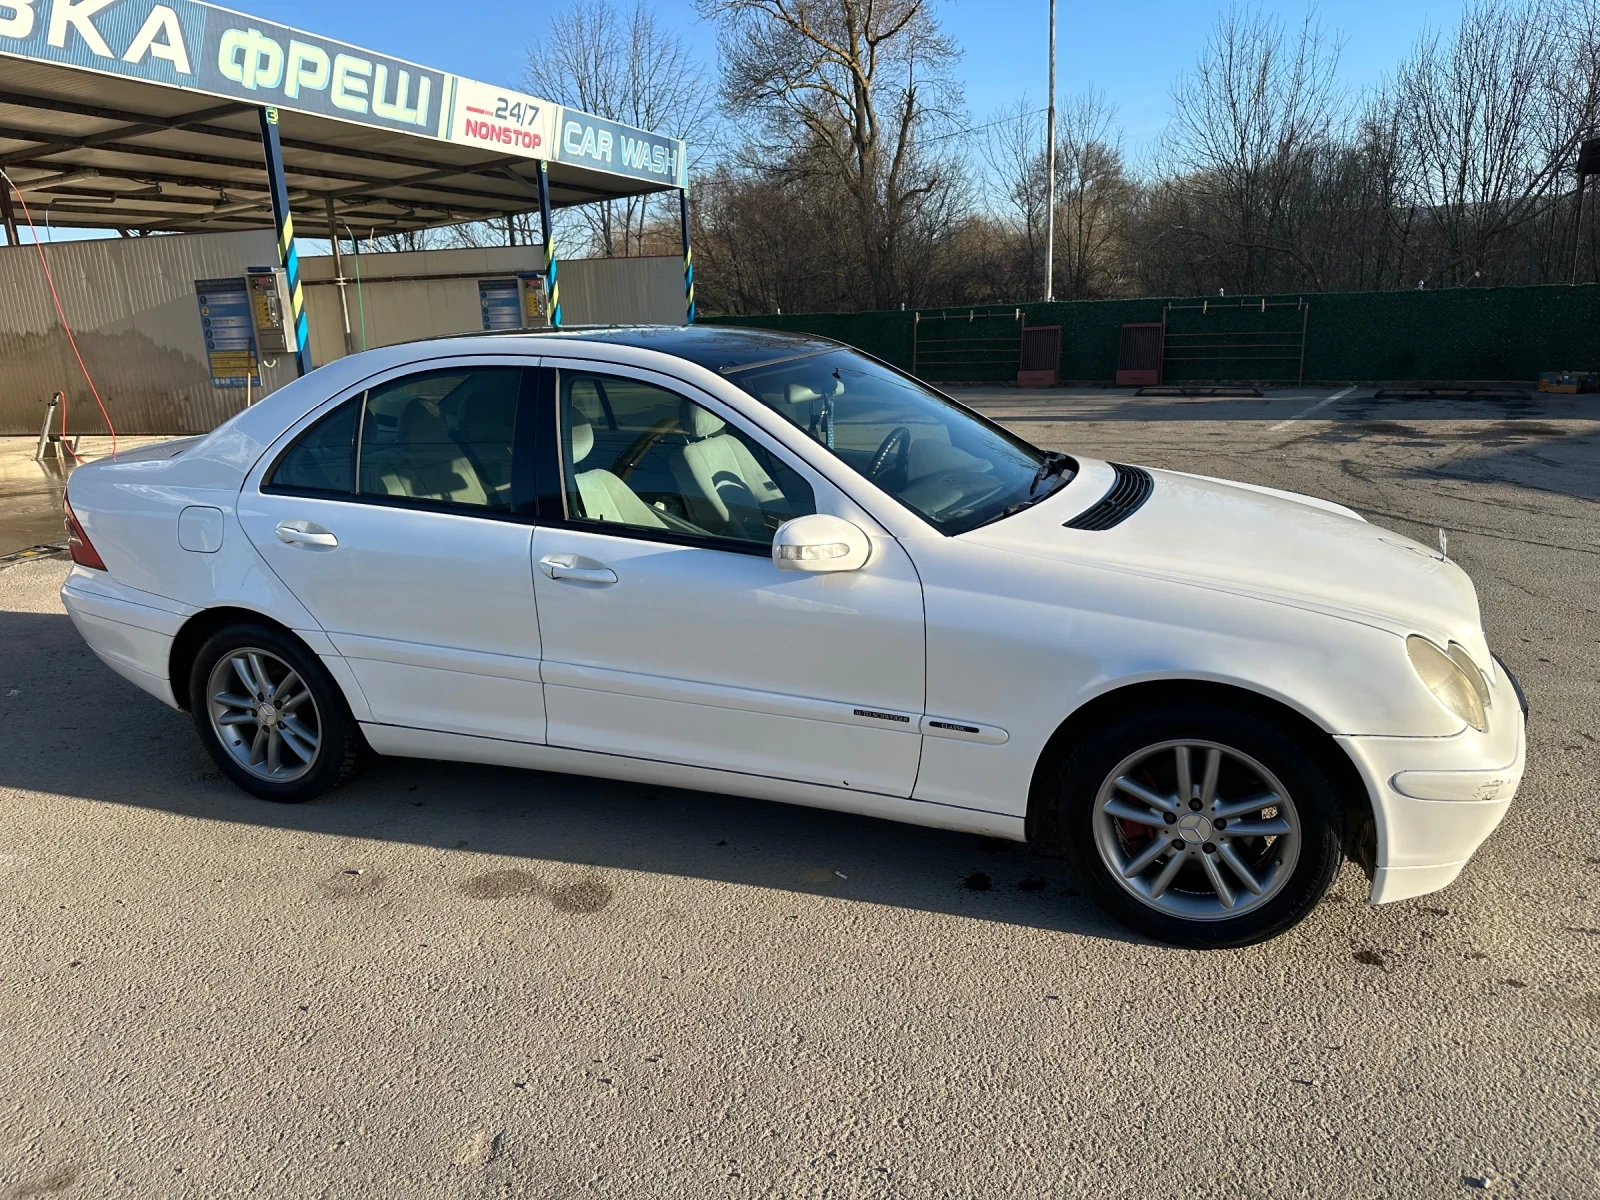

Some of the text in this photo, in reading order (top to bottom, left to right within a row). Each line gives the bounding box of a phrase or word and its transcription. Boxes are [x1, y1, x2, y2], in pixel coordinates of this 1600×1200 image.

[218, 27, 432, 127] ФРЕШ
[494, 97, 540, 127] 24/7
[464, 118, 542, 149] NONSTOP
[563, 120, 678, 177] CAR WASH
[941, 723, 966, 731] CLASSIC
